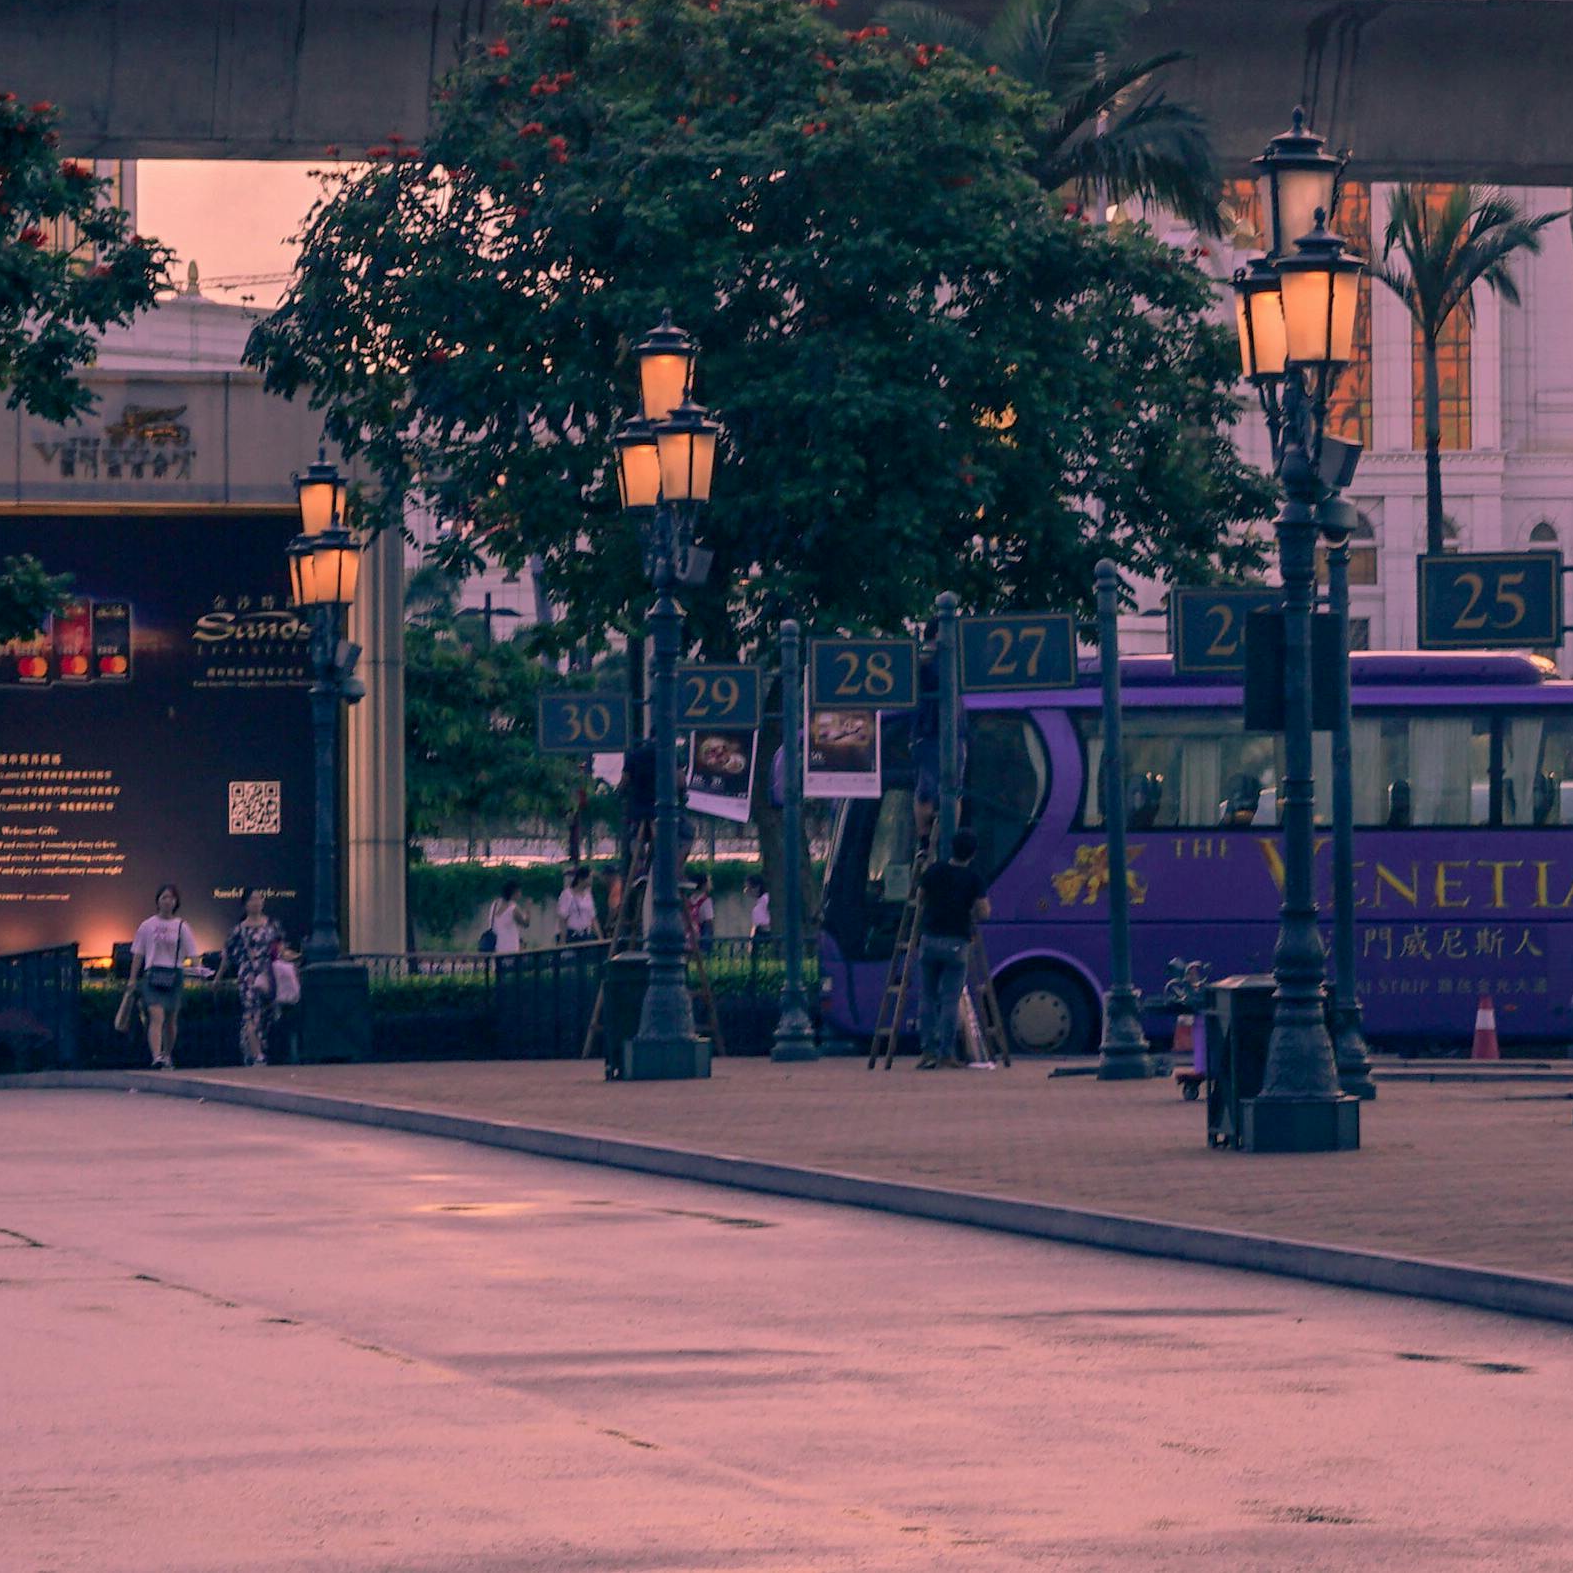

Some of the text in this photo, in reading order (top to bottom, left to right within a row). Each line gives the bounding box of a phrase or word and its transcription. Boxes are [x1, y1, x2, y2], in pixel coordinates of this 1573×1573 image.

[1453, 570, 1526, 629] 25
[192, 611, 314, 641] Sands
[1206, 604, 1271, 656] 2
[987, 627, 1047, 676] 27
[835, 651, 894, 696] 28
[684, 676, 739, 717] 29
[561, 703, 611, 743] 30
[1172, 838, 1229, 859] THE
